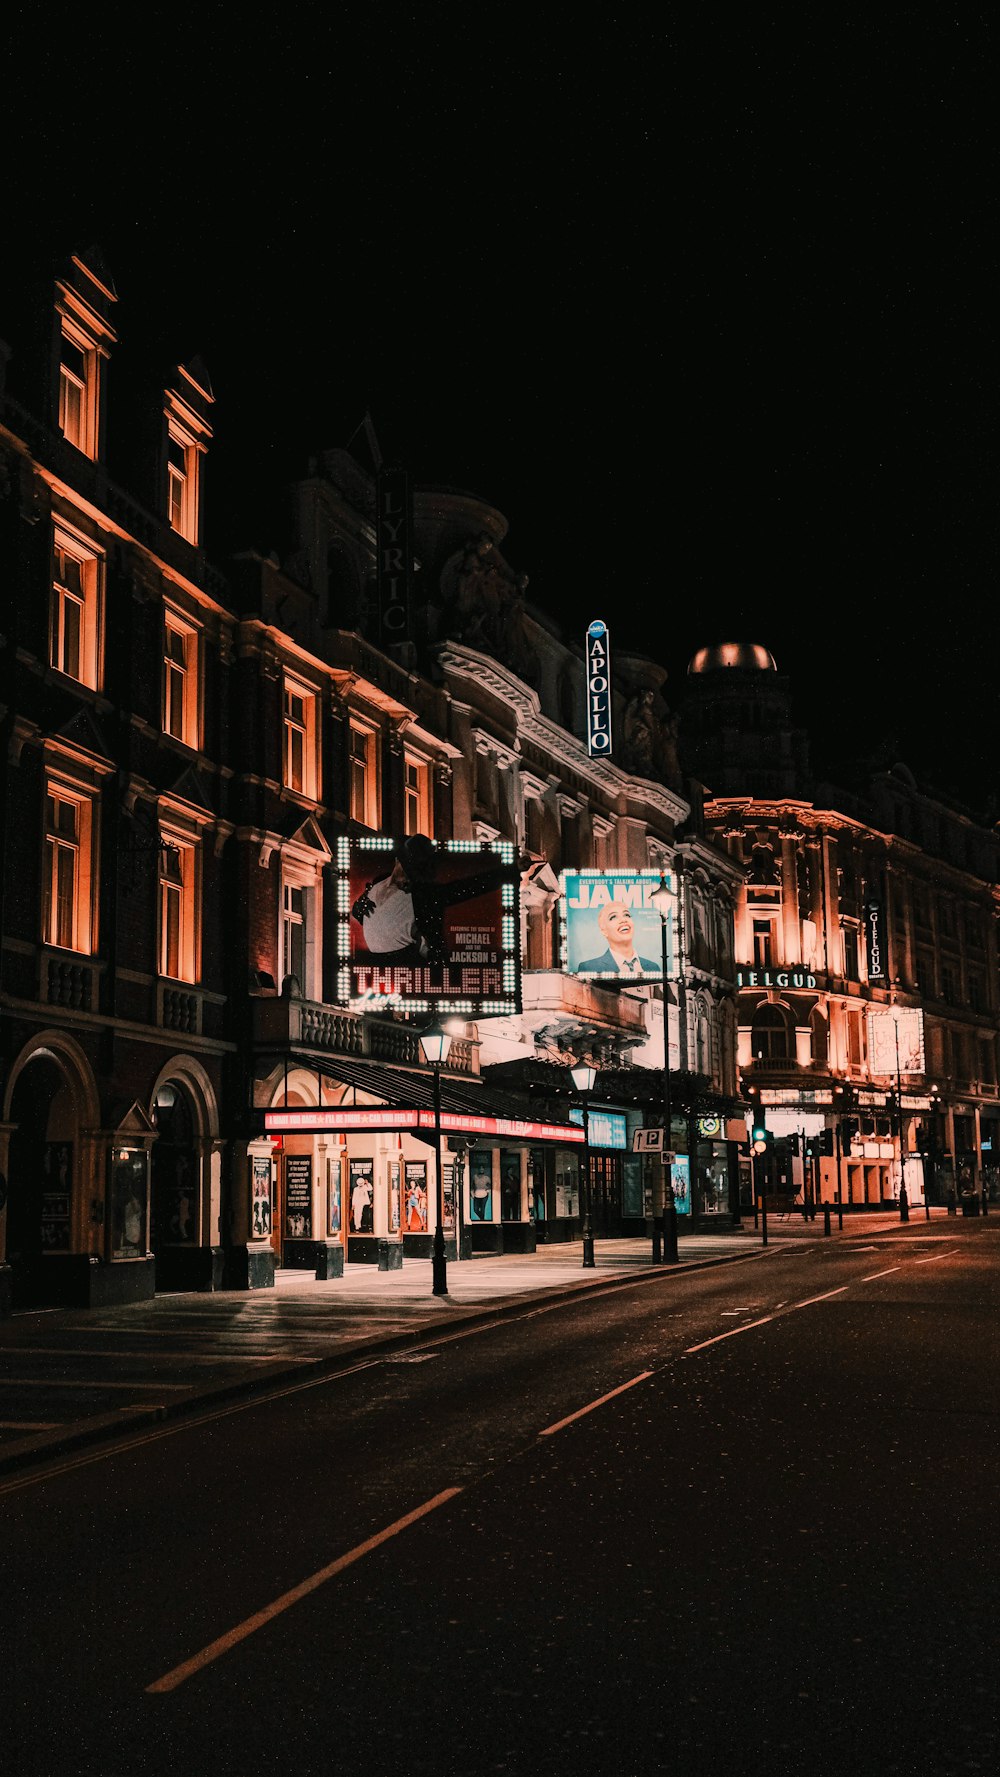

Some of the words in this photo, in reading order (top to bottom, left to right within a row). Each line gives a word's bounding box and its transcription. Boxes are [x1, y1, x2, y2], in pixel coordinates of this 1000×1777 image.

[382, 492, 406, 630] LYRIC
[590, 639, 609, 749] APOLLO
[568, 884, 661, 909] JAMI
[455, 933, 491, 945] MICHAEL
[869, 912, 881, 975] GIELGUD
[449, 951, 488, 963] JACKSON
[490, 952, 497, 963] 5
[353, 966, 501, 994] THRILLER
[649, 1132, 658, 1144] P
